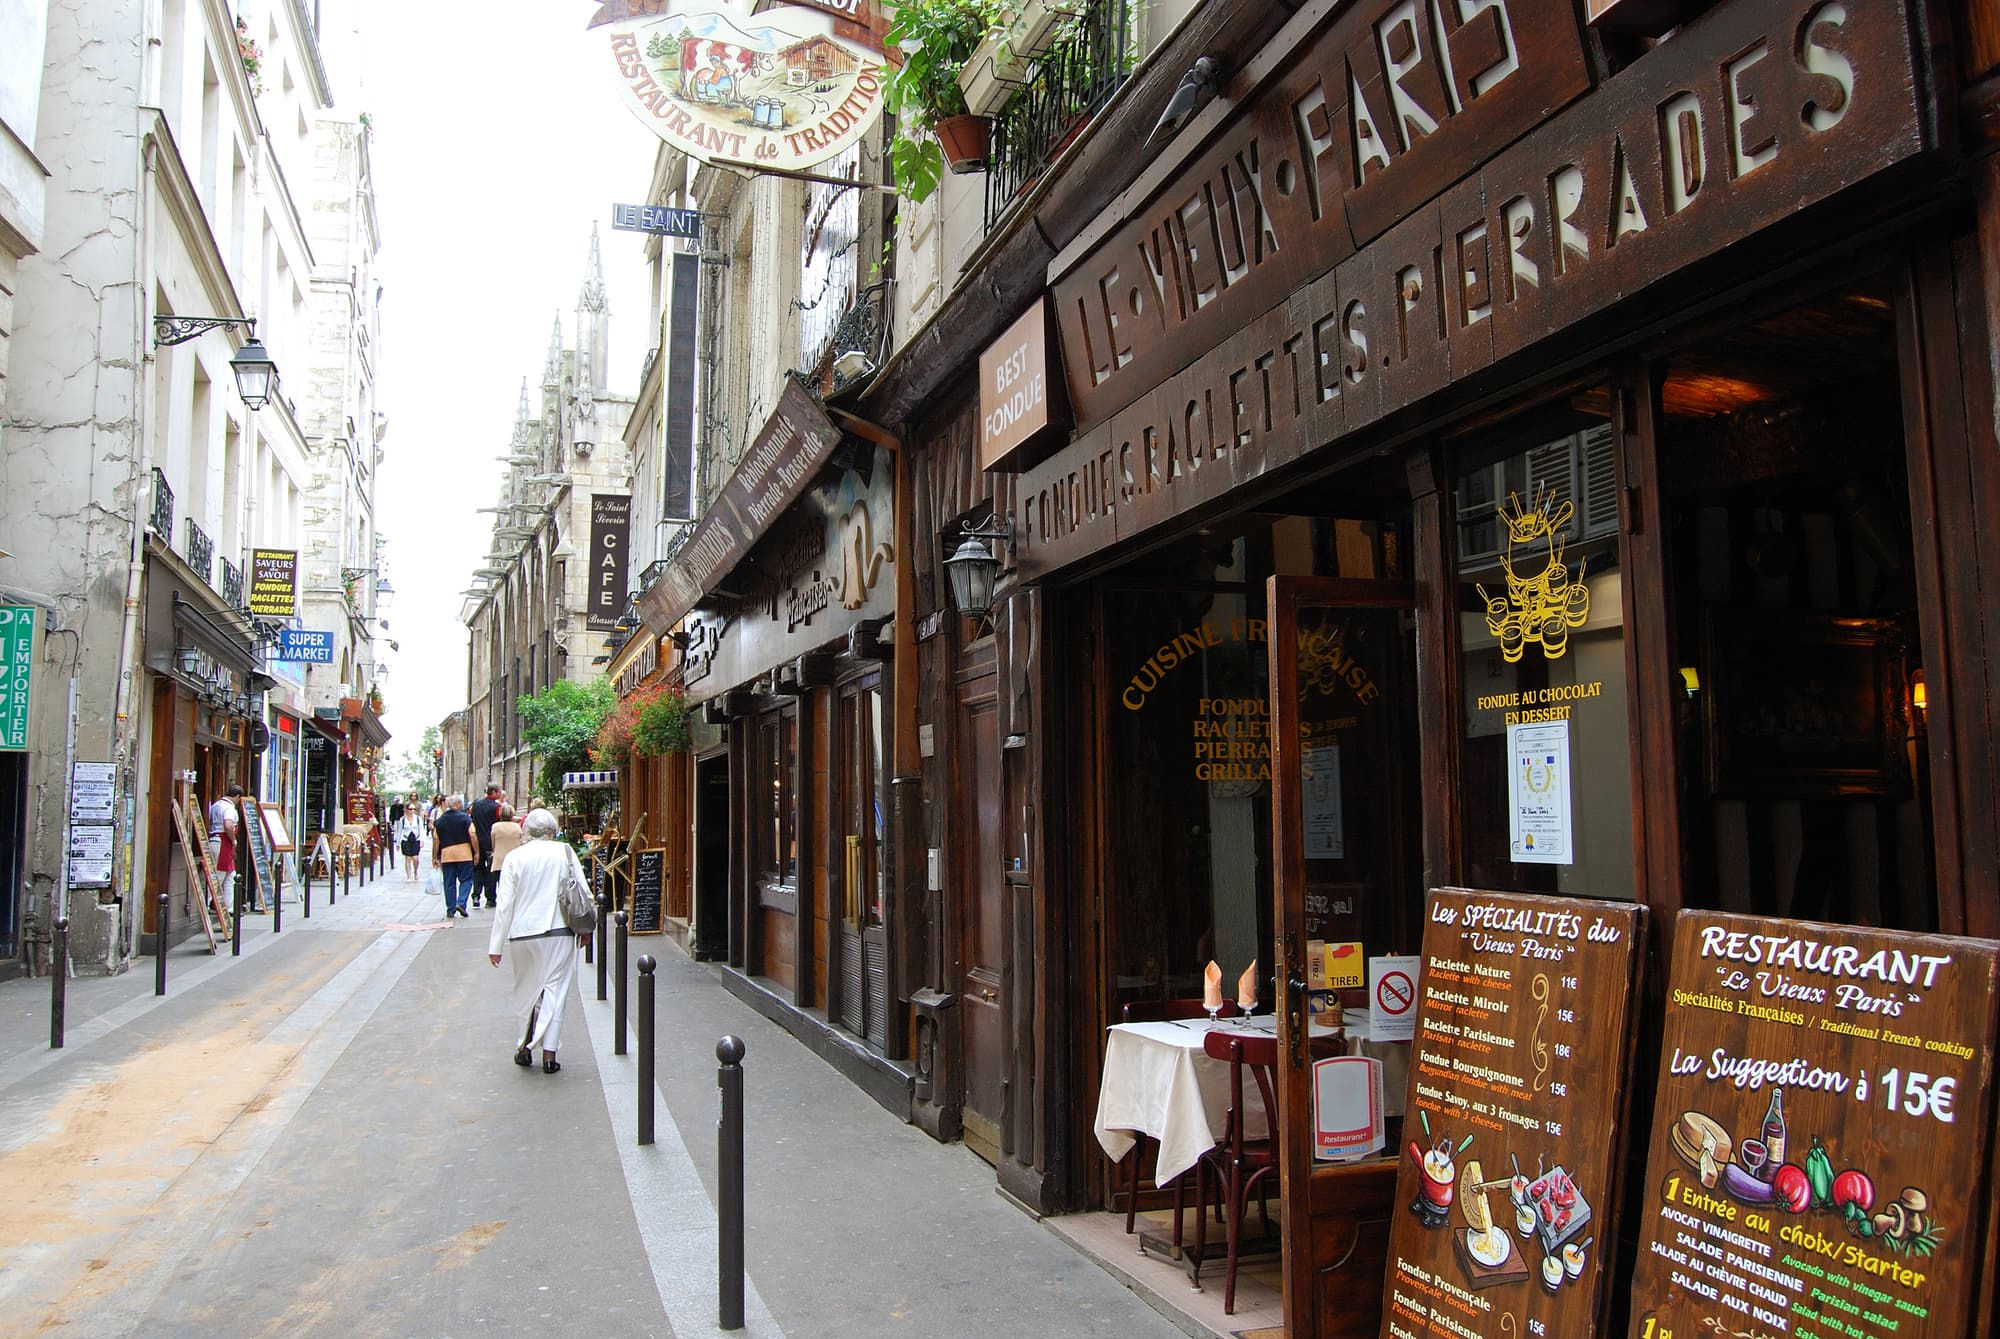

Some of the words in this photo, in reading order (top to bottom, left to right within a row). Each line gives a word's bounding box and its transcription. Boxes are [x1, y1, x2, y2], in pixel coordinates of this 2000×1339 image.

[611, 31, 747, 158] RESTAURANT
[754, 136, 779, 160] de
[784, 61, 881, 157] TRADITION
[1396, 2, 1855, 361] PIERRADES
[614, 205, 636, 228] LE
[641, 207, 696, 234] SAINT
[1078, 264, 1134, 388] LE
[1138, 135, 1280, 331] VIEUX
[996, 343, 1028, 393] BEST
[985, 373, 1042, 443] FONDUE
[256, 559, 294, 569] SAVEURS
[257, 552, 295, 560] RESTAURANT
[600, 533, 617, 606] CAFE
[255, 583, 292, 592] FONDUES
[258, 571, 290, 580] SAVOIE
[250, 604, 295, 614] PIERRADES
[251, 593, 295, 603] RACLETTES
[282, 647, 330, 660] MARKET
[289, 633, 325, 646] SUPER
[1122, 622, 1223, 711] CUISINE
[11, 638, 30, 744] EMPORTER
[1478, 693, 1519, 710] FONDUE
[1522, 690, 1536, 705] AU
[1539, 682, 1602, 703] CHOCOLAT
[1199, 698, 1271, 716] FONDU
[1505, 712, 1519, 725] EN
[1522, 705, 1571, 724] DESSERT
[1431, 902, 1458, 926] Les
[1462, 903, 1582, 940] SPÉCIALITÉS
[1587, 918, 1620, 943] du
[1430, 957, 1470, 974] Raclette
[1474, 964, 1511, 979] Nature
[1700, 926, 1950, 989] RESTAURANT
[1330, 976, 1359, 986] TIRER
[1429, 969, 1460, 983] Raclette
[1462, 974, 1480, 985] with
[1482, 978, 1512, 991] cheese
[1561, 976, 1578, 990] 11€
[1756, 971, 1826, 1003] Vieux
[1425, 999, 1453, 1012] Mirror
[1456, 1005, 1489, 1020] raclette
[1427, 987, 1469, 1005] Raclette
[1473, 996, 1509, 1014] Miroir
[1557, 1009, 1574, 1023] 15€
[1673, 988, 1733, 1013] Spécialités
[1738, 1000, 1804, 1026] Françaises
[1820, 1018, 1879, 1040] Traditional
[1882, 1030, 1921, 1049] French
[1925, 1039, 1974, 1060] cooking
[1424, 1017, 1460, 1036] Raclette
[1463, 1026, 1515, 1048] Parisienne
[1457, 1040, 1491, 1054] raclette
[1554, 1043, 1571, 1058] 18€
[1419, 1063, 1459, 1081] Burgundian
[1461, 1073, 1488, 1089] fondue
[1491, 1083, 1508, 1095] with
[1510, 1090, 1533, 1102] meat
[1420, 1049, 1450, 1067] Fondue
[1453, 1056, 1524, 1088] Bourguignonne
[1550, 1081, 1567, 1097] 15€
[1670, 1047, 1702, 1075] La
[1706, 1047, 1850, 1094] Suggestion
[1855, 1069, 1869, 1101] à
[1882, 1068, 1957, 1123] 15€
[1415, 1096, 1442, 1112] Fondue
[1443, 1105, 1461, 1118] with
[1462, 1111, 1469, 1120] 3
[1470, 1115, 1504, 1131] cheeses
[1416, 1082, 1443, 1100] Fondue
[1472, 1101, 1488, 1114] aux
[1490, 1104, 1496, 1116] 3
[1498, 1106, 1540, 1130] Fromages
[1545, 1120, 1562, 1136] 15€
[1665, 1177, 1681, 1201] 1
[1683, 1188, 1737, 1222] Entrée
[1745, 1213, 1770, 1234] au
[1660, 1206, 1701, 1230] AVOCAT
[1702, 1221, 1772, 1258] VINAIGRETTE
[1781, 1254, 1824, 1278] Avocado
[1826, 1272, 1850, 1288] with
[1852, 1282, 1893, 1304] vinegar
[1894, 1297, 1928, 1318] sauce
[1395, 1270, 1442, 1300] Provençale
[1444, 1294, 1478, 1318] fondue
[1397, 1257, 1431, 1283] Fondue
[1434, 1275, 1491, 1313] Provençale
[1650, 1241, 1687, 1264] SALADE
[1689, 1258, 1704, 1272] AU
[1706, 1264, 1747, 1290] CHÈVRE
[1749, 1282, 1788, 1308] CHAUD
[1791, 1302, 1818, 1320] Salad
[1820, 1315, 1844, 1331] with
[1845, 1324, 1864, 1339] hot
[1676, 1231, 1723, 1261] SALADE
[1726, 1252, 1804, 1292] PARISIENNE
[1810, 1287, 1860, 1315] Parisian
[1862, 1309, 1899, 1331] salad
[1391, 1301, 1426, 1326] Parisian
[1393, 1289, 1427, 1316] Fondue
[1671, 1271, 1719, 1300] SALADE
[1721, 1293, 1749, 1314] AUX
[1752, 1306, 1787, 1331] NOIX
[1528, 1318, 1545, 1337] 15€
